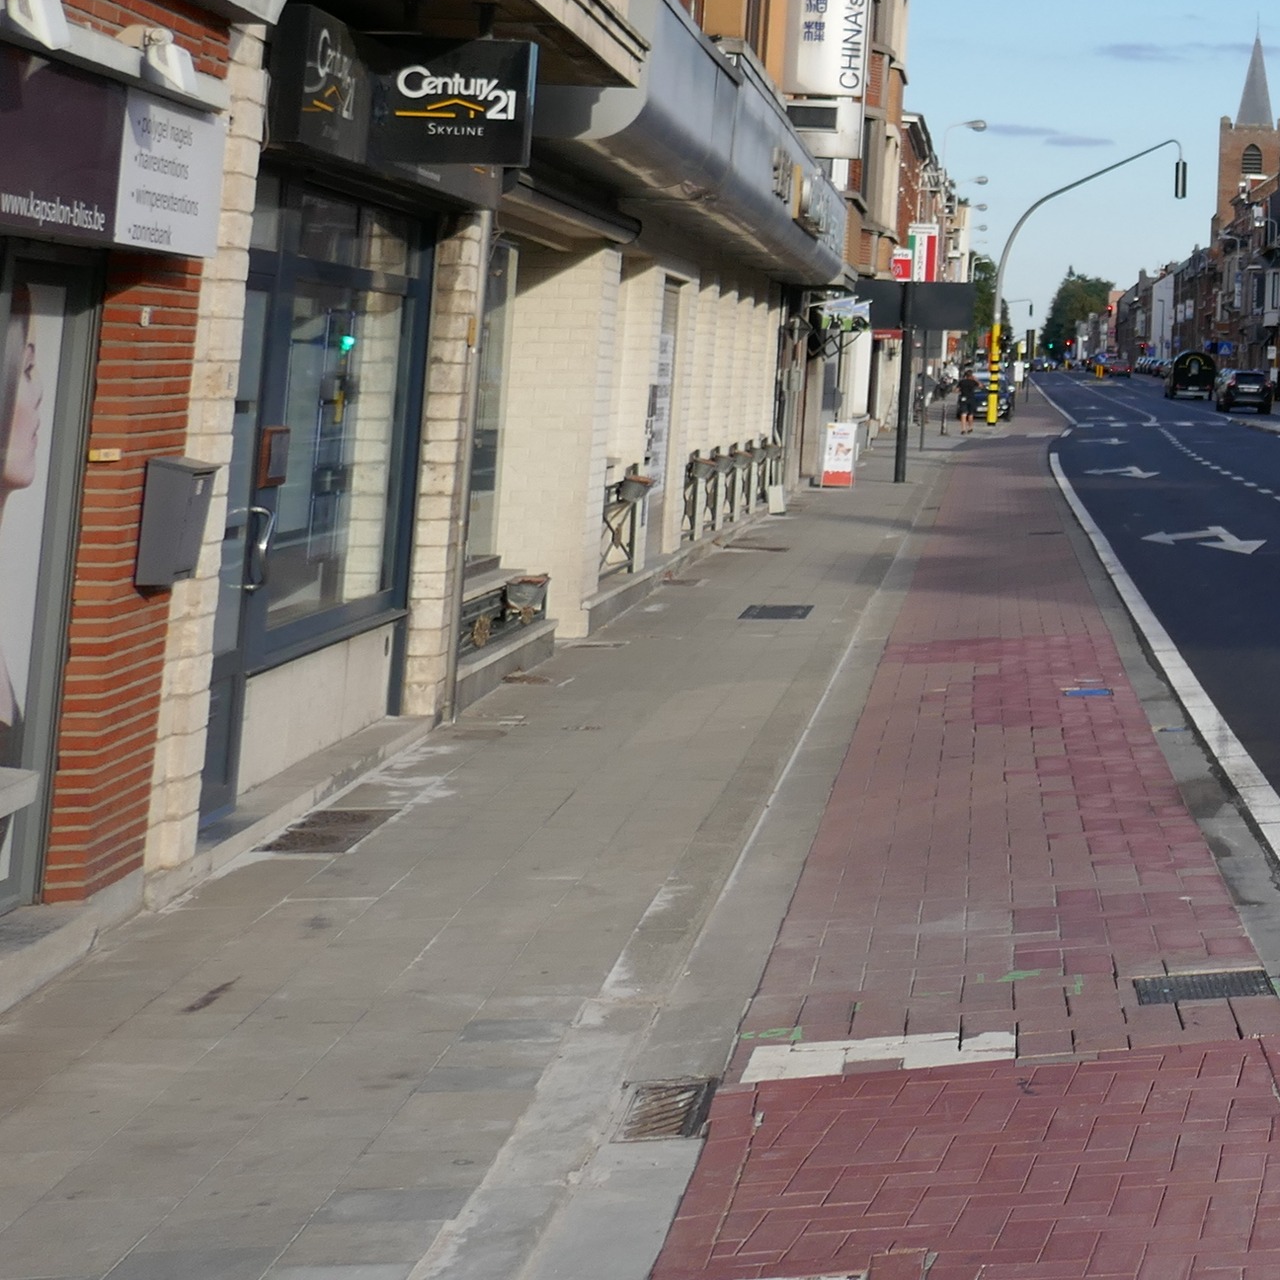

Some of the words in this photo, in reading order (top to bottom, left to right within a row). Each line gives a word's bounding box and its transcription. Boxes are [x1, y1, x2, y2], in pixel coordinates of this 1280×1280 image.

[397, 65, 499, 100] Century
[485, 89, 517, 120] 21
[427, 122, 485, 136] SKYLINE
[0, 190, 105, 232] www.kapsalon-bliss.be
